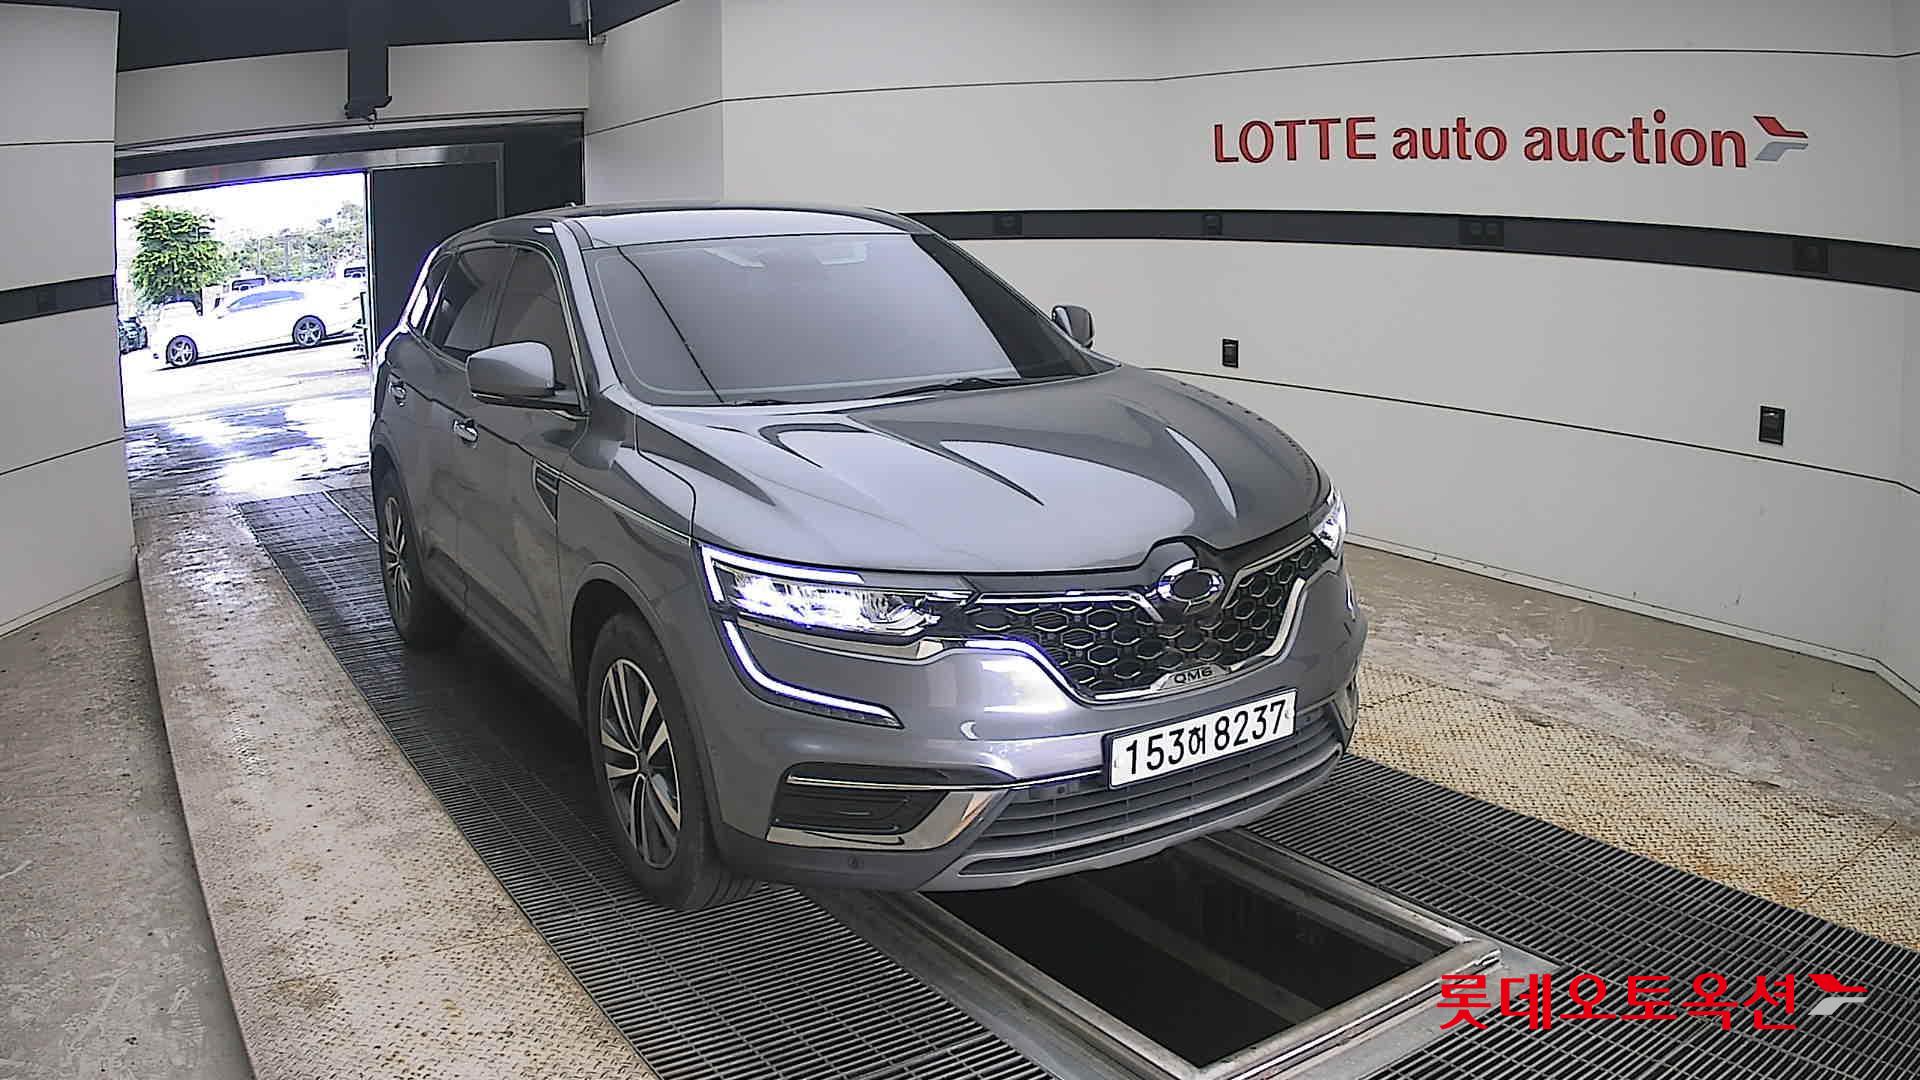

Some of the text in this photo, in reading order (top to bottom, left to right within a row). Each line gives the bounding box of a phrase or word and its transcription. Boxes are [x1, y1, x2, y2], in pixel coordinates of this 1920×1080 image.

[1213, 109, 1747, 168] LOTTE auto auction
